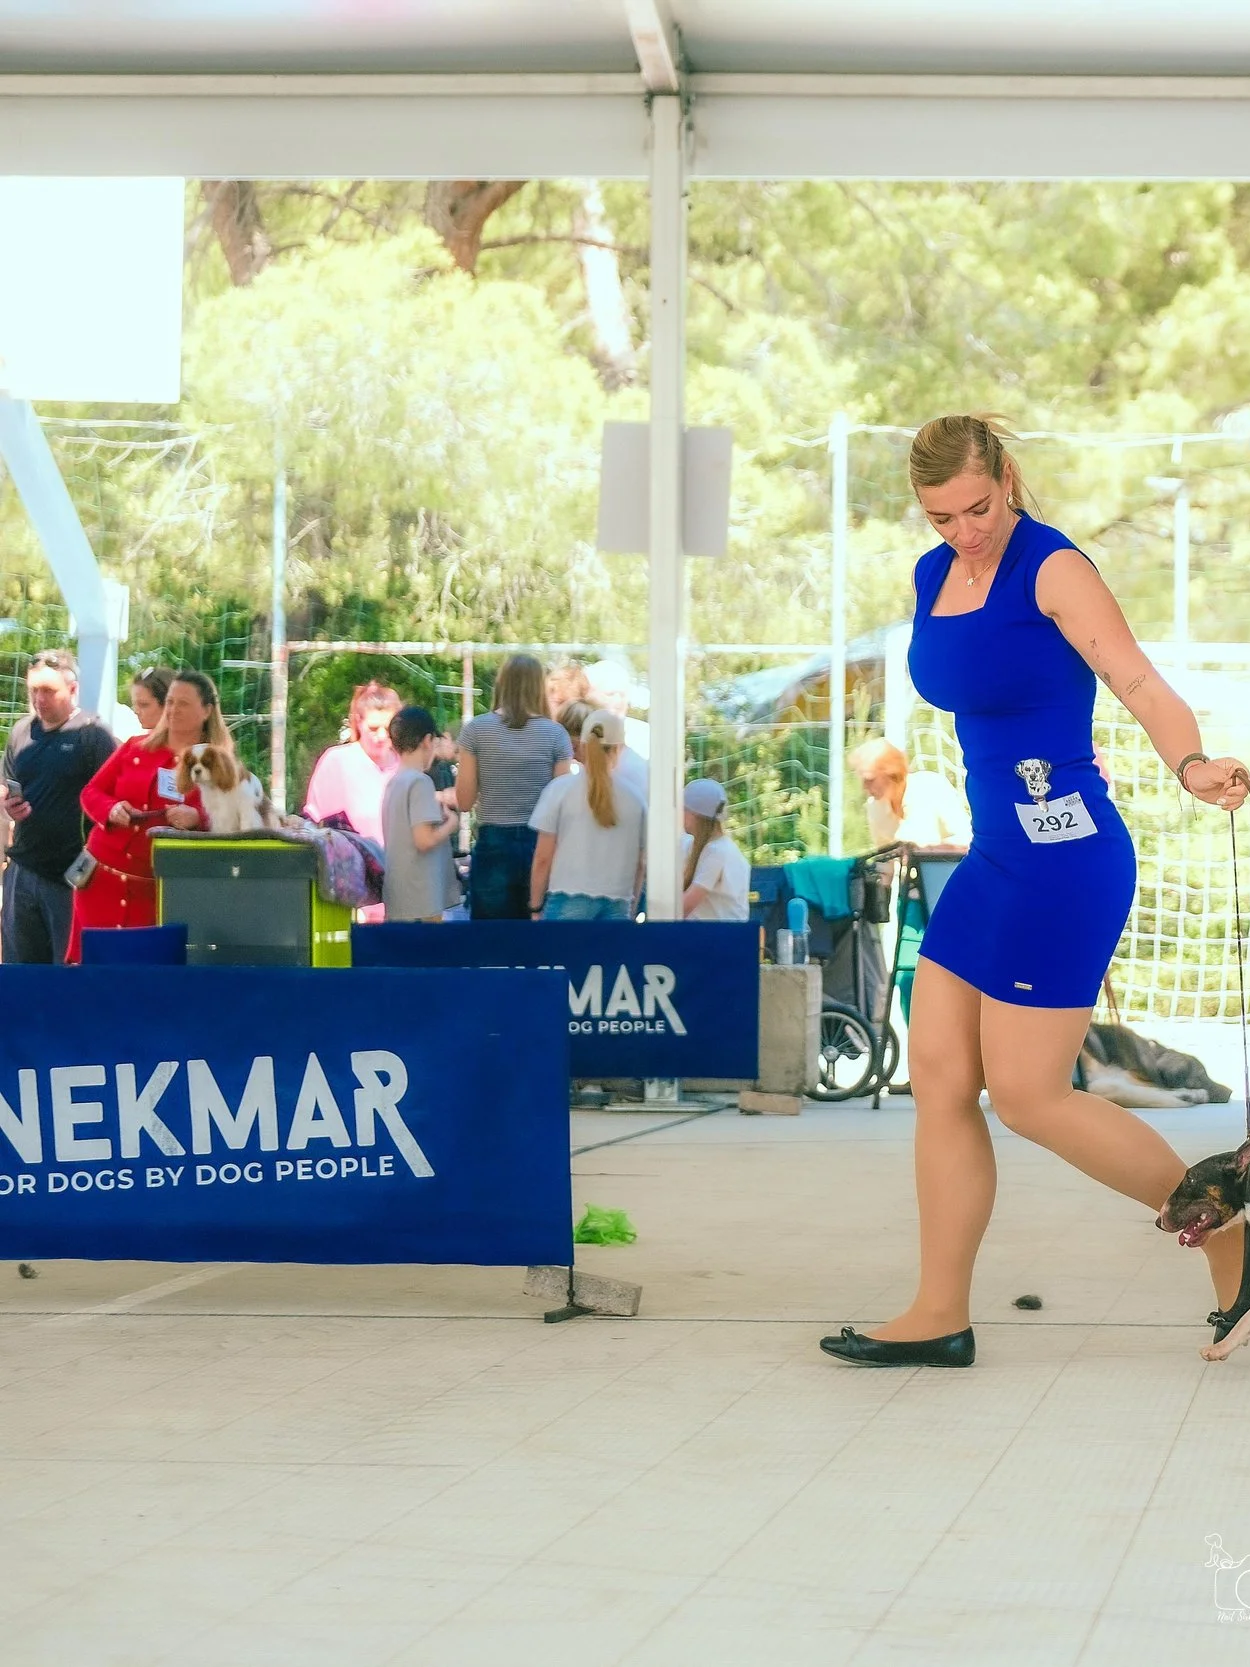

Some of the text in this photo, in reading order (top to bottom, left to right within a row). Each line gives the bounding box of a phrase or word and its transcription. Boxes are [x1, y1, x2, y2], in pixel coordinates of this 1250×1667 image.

[1032, 812, 1079, 832] 292
[553, 964, 688, 1036] MAR
[568, 1020, 665, 1034] OG PEOPLE
[0, 1050, 435, 1178] NEKMAR
[0, 1155, 395, 1195] OR DOGS BY DOG PEOPLE
